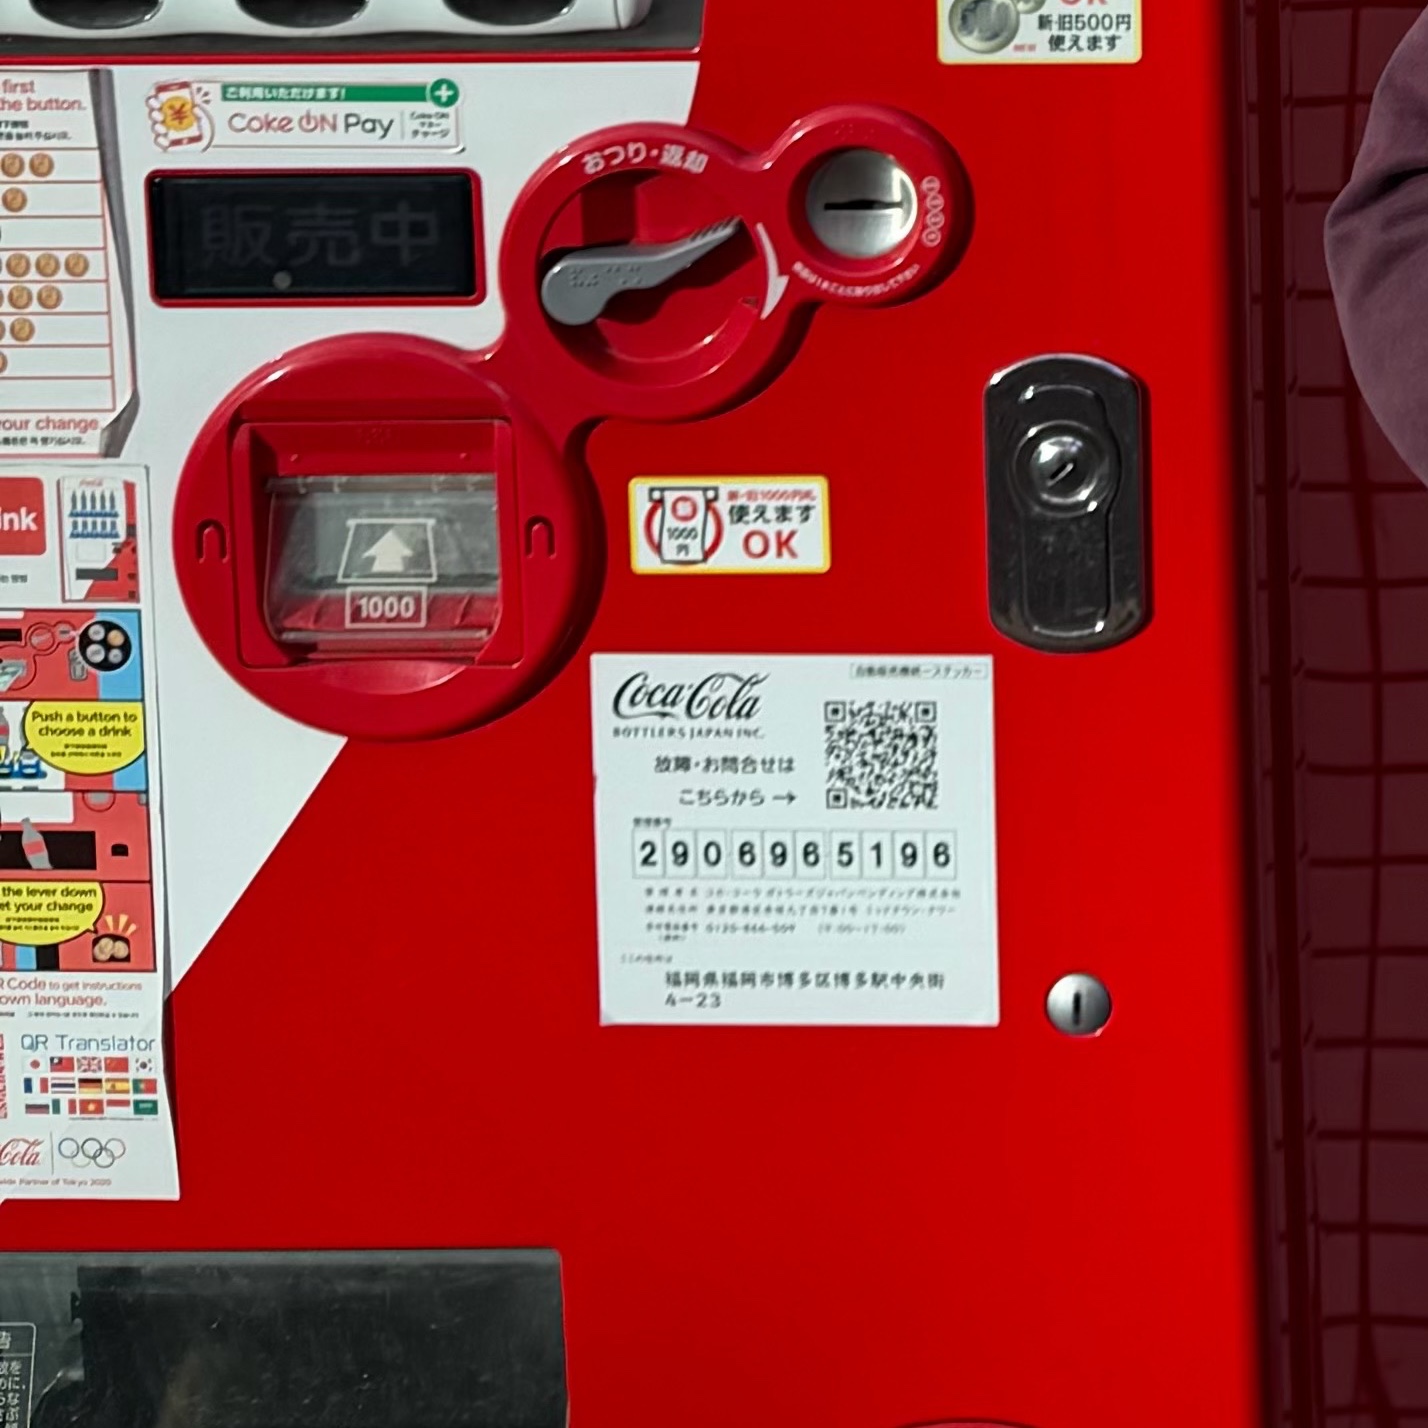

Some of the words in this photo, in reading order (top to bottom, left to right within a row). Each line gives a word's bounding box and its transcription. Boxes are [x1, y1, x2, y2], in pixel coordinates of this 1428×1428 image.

[1048, 33, 1122, 53] 使えます
[228, 112, 295, 134] Coke
[343, 113, 394, 140] Pay
[202, 198, 440, 268] 販売中
[728, 504, 816, 527] 使えます
[742, 529, 799, 559] OK
[358, 596, 416, 620] 1000
[612, 670, 770, 721] Coca-Cola
[31, 711, 63, 724] Push
[77, 711, 121, 724] button
[124, 712, 138, 723] to
[38, 725, 84, 737] choose
[99, 725, 132, 737] drink
[654, 755, 795, 774] 故障・お問合せは
[680, 788, 766, 806] こちらから
[26, 886, 58, 898] lever
[60, 886, 98, 898] down
[20, 1033, 49, 1052] QR
[55, 1033, 157, 1052] Translator
